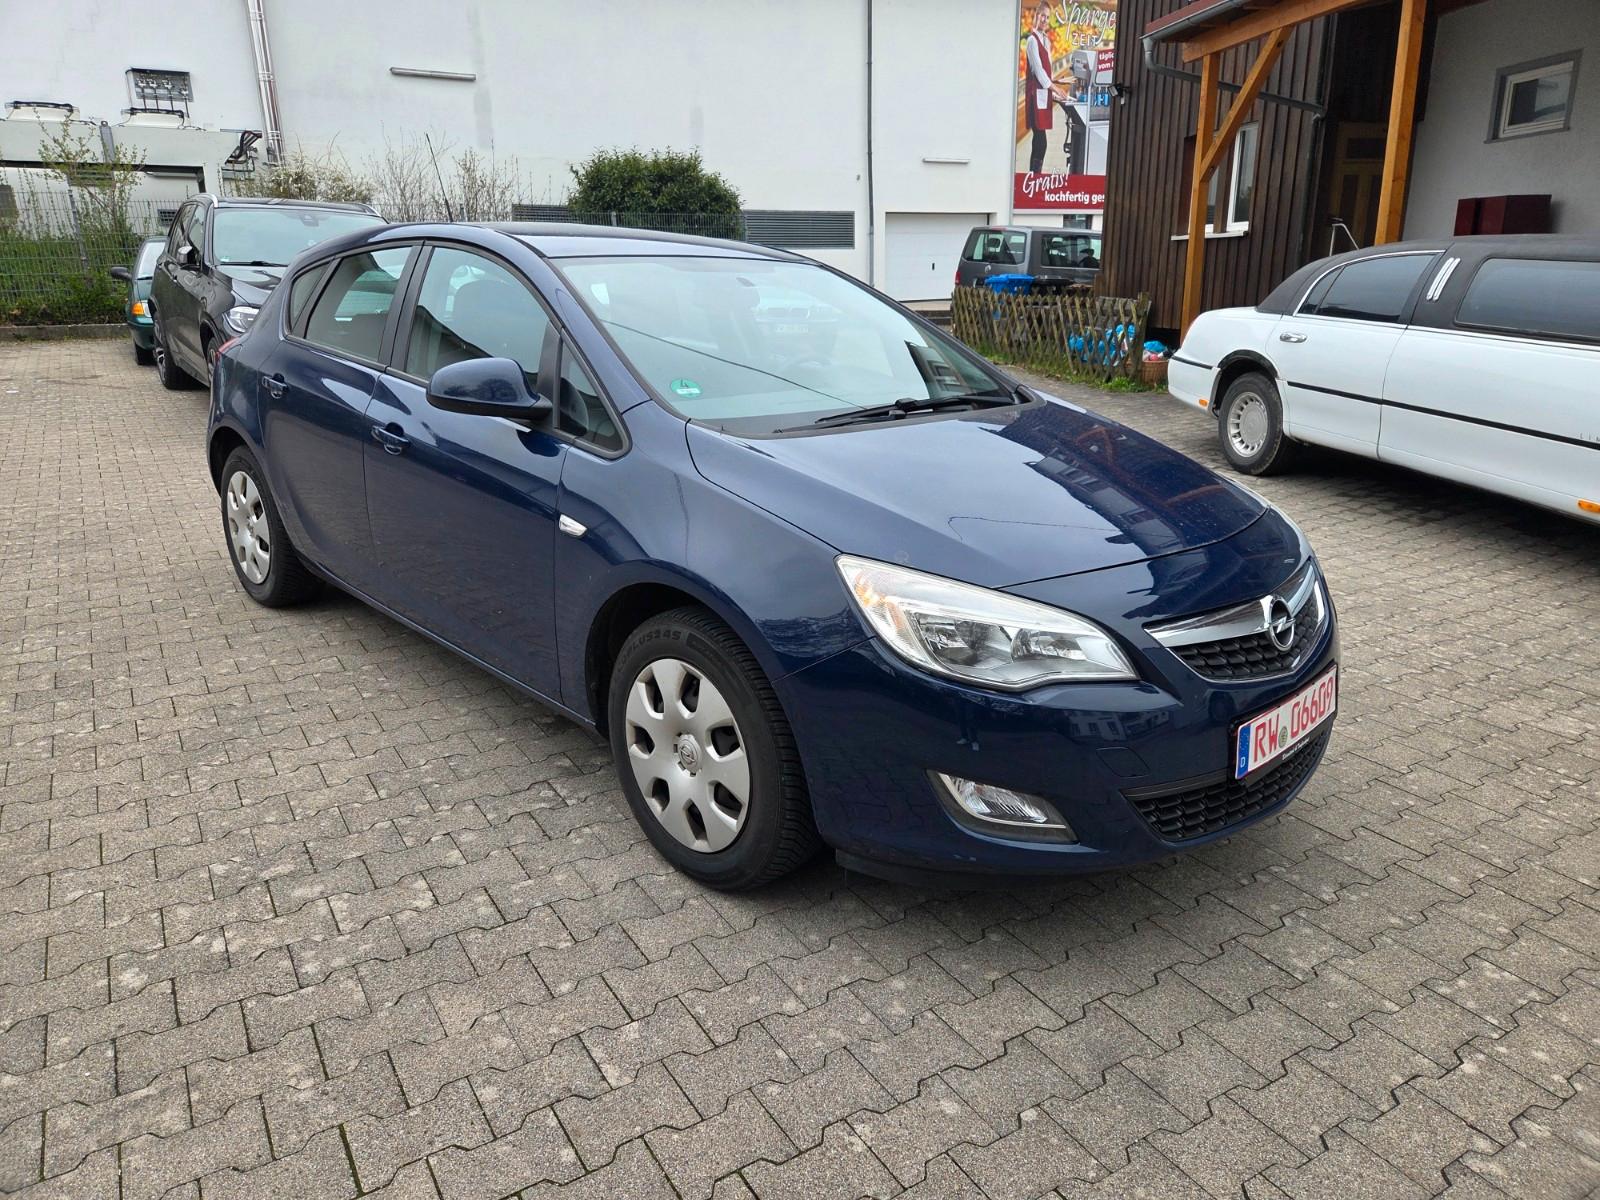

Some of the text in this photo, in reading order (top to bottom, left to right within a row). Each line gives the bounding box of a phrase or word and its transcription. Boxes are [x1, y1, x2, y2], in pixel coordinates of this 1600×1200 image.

[1072, 32, 1098, 46] ZEIT
[1098, 62, 1111, 71] vom
[1022, 164, 1070, 198] Gratis!
[1044, 190, 1090, 205] kochfertig
[1254, 713, 1280, 762] RW
[1290, 676, 1334, 738] 06609
[1240, 757, 1246, 768] D
